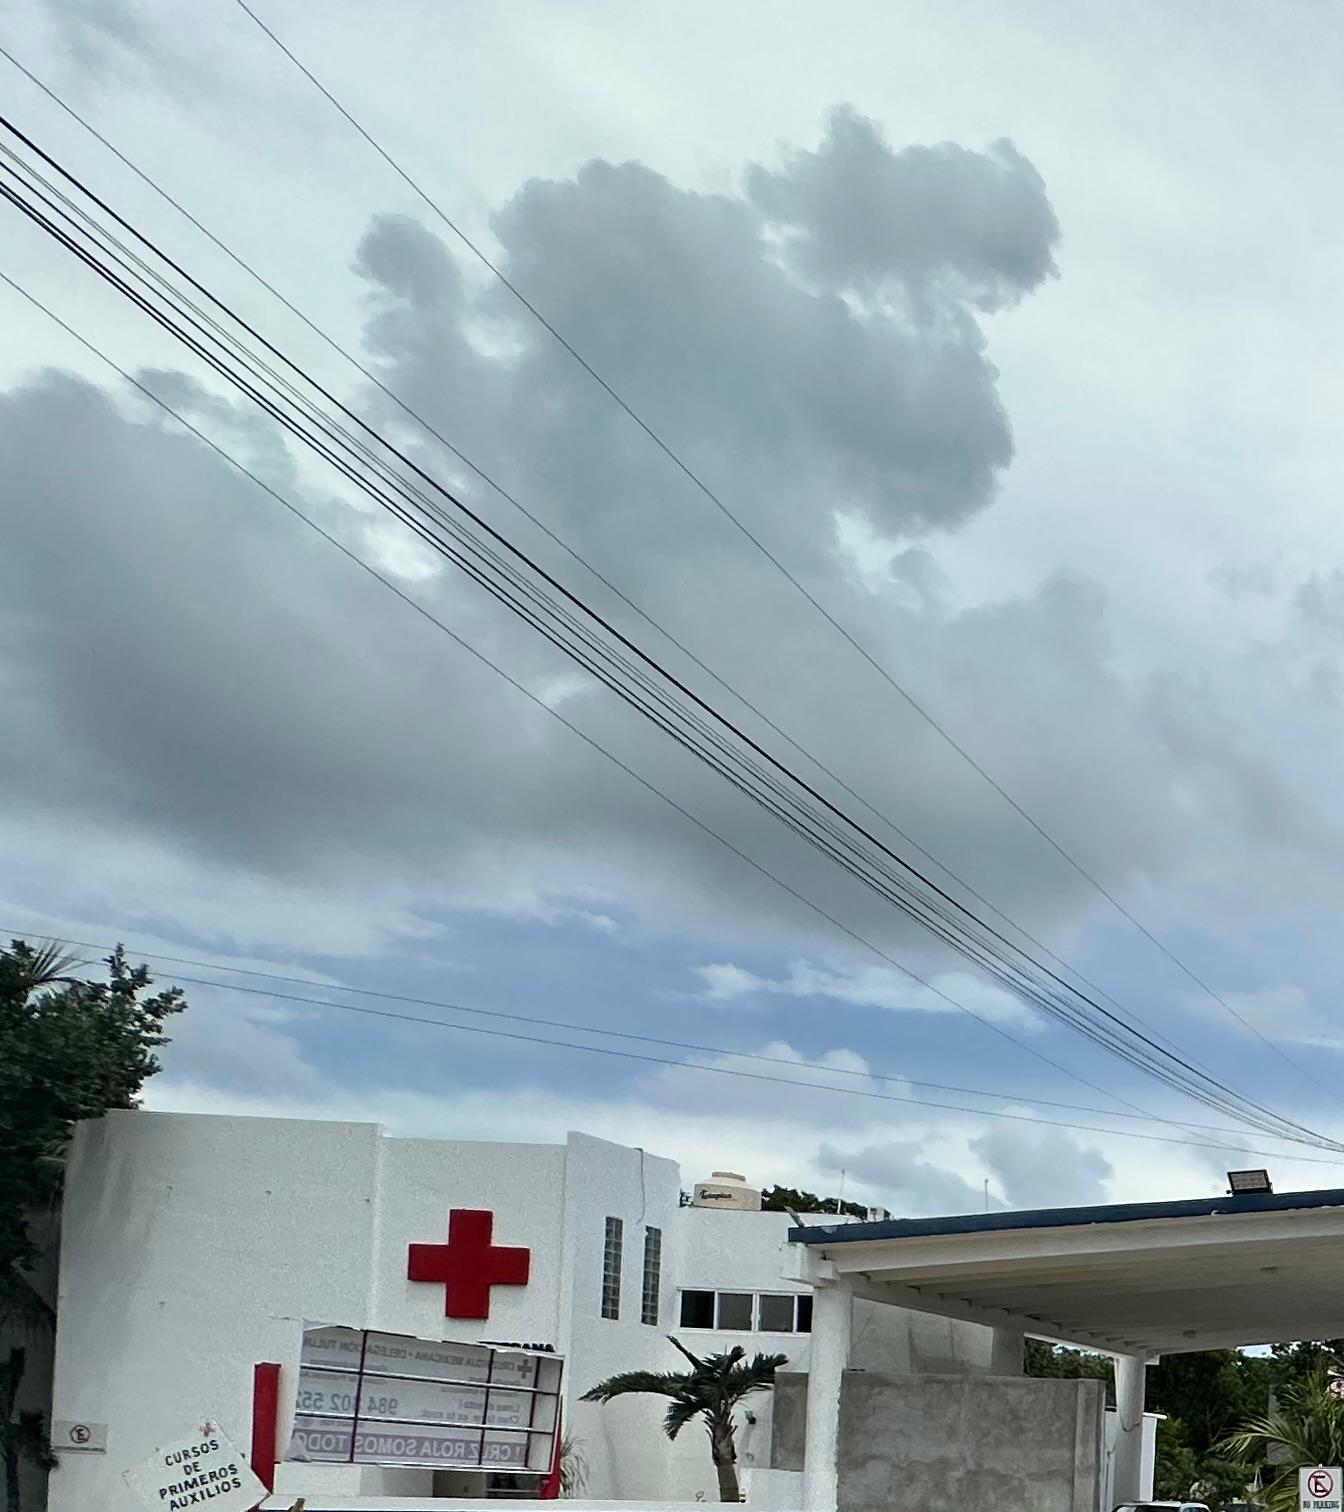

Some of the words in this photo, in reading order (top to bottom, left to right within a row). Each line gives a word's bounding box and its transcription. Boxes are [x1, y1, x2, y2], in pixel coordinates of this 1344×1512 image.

[165, 1439, 220, 1466] CURSOS
[159, 1463, 238, 1499] PRIMEROS
[183, 1461, 202, 1476] DE
[169, 1477, 242, 1512] AUXILIOS
